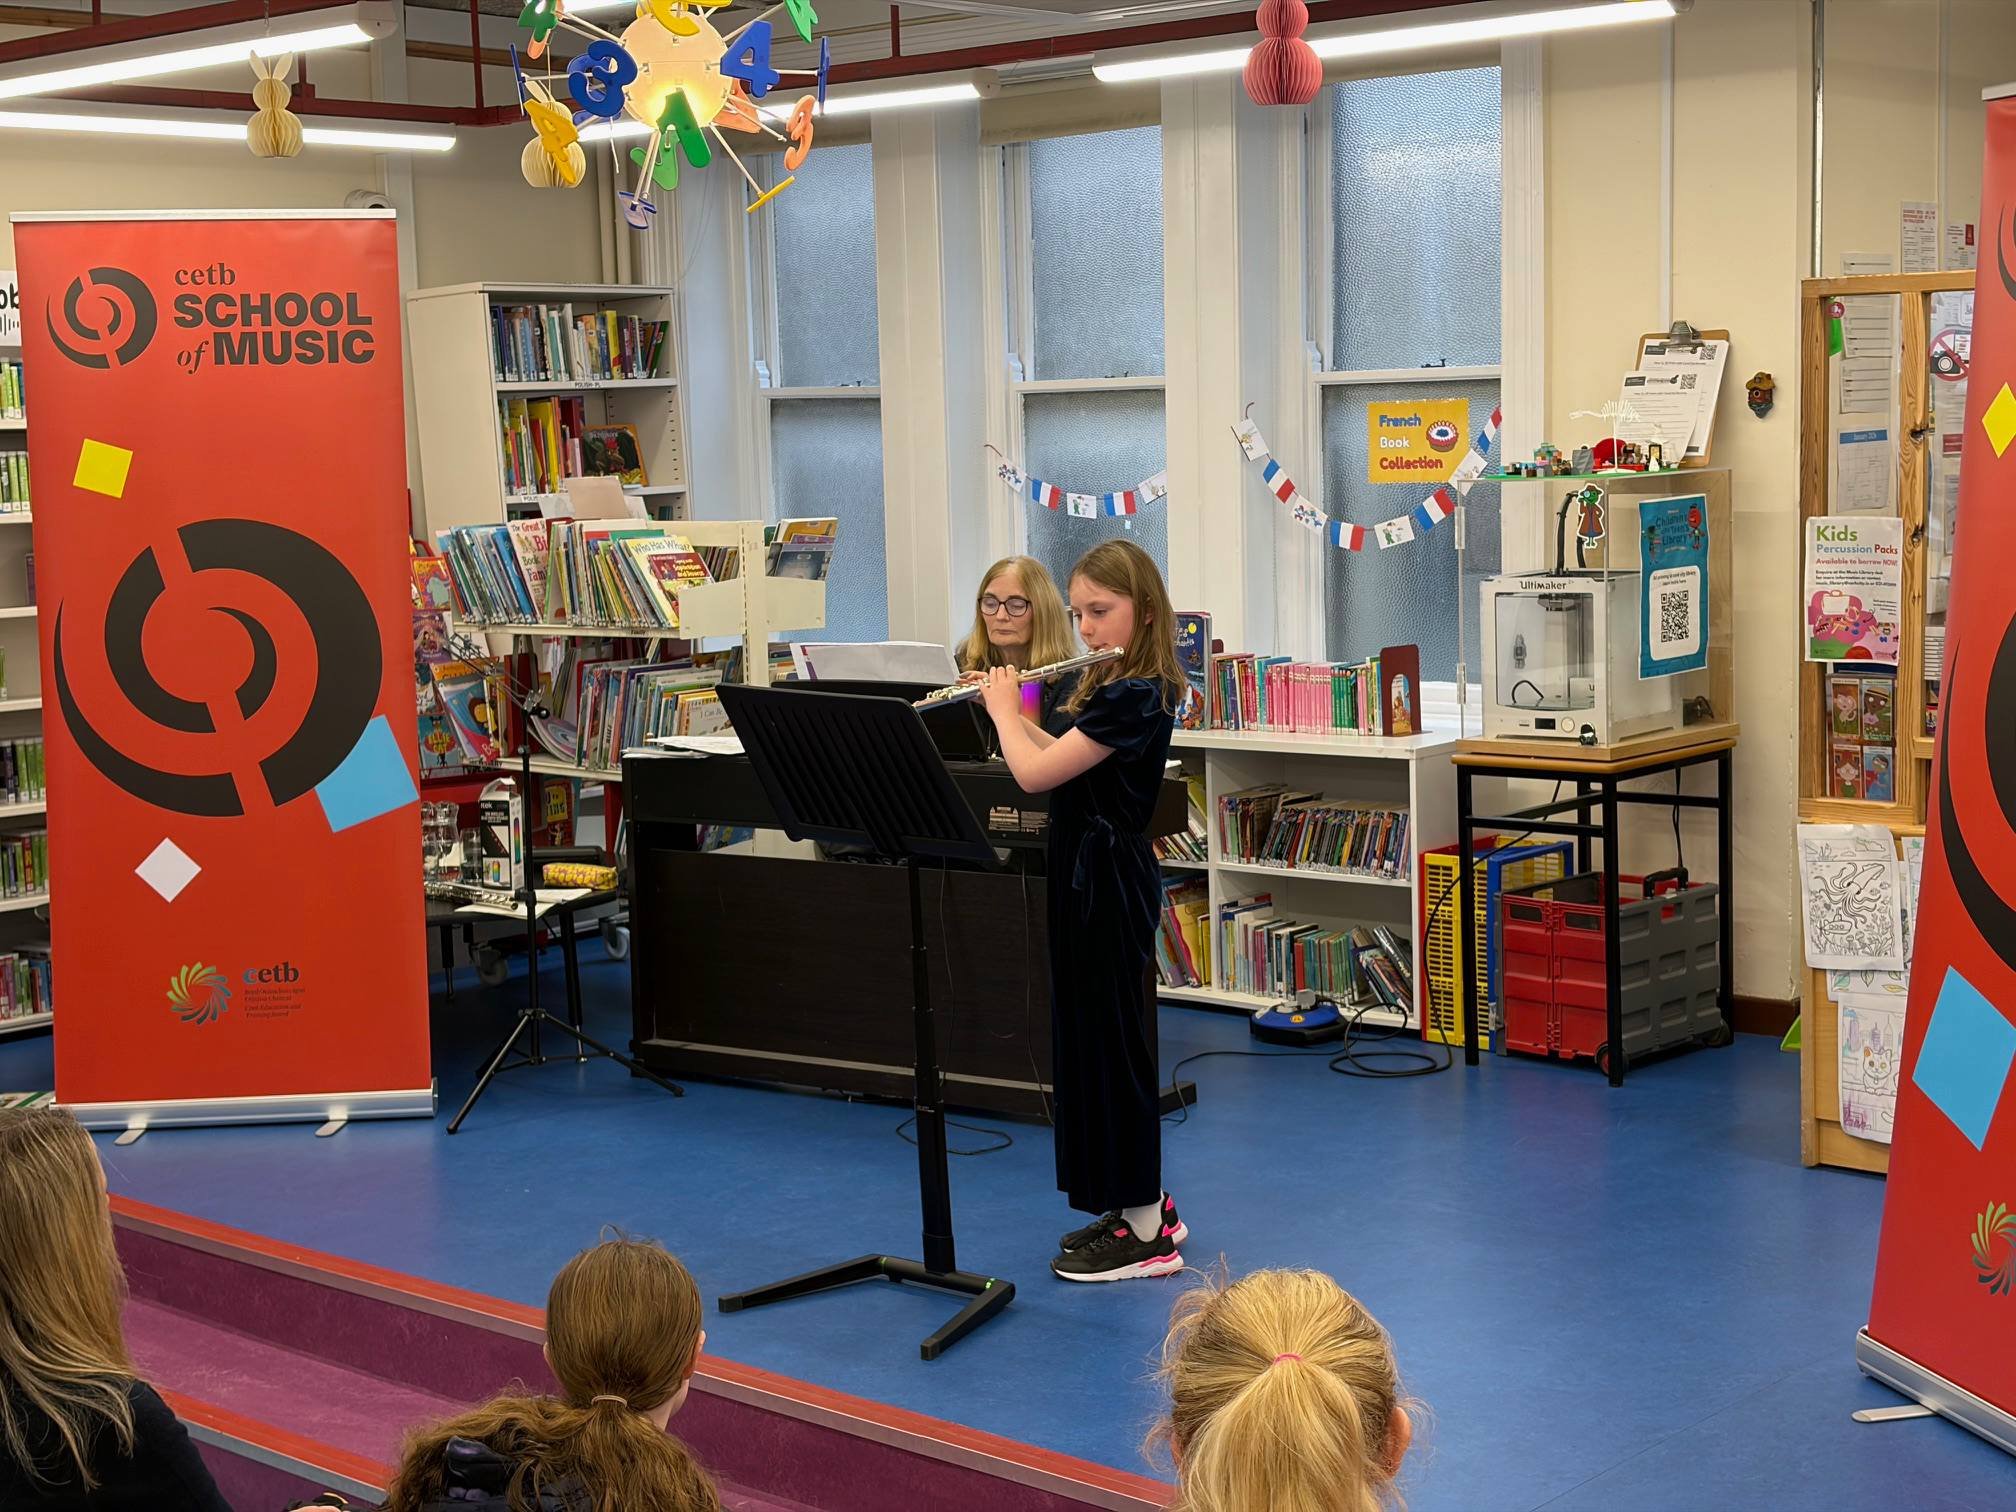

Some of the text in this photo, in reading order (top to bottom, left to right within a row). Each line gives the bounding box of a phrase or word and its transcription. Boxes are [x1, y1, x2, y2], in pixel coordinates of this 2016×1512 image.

[174, 262, 236, 286] cetb
[173, 292, 373, 328] SCHOOL
[176, 329, 375, 375] of MUSIC
[1379, 413, 1422, 428] French
[1380, 436, 1410, 448] Book
[1379, 455, 1444, 470] Collection
[521, 521, 540, 532] Great
[1816, 525, 1858, 542] Kids
[533, 535, 548, 552] Bi
[632, 537, 690, 554] Who Has What?
[1663, 535, 1687, 546] Library
[1816, 544, 1898, 555] Percussion Packs
[1520, 581, 1567, 590] Ultimaker
[242, 961, 299, 984] cetb
